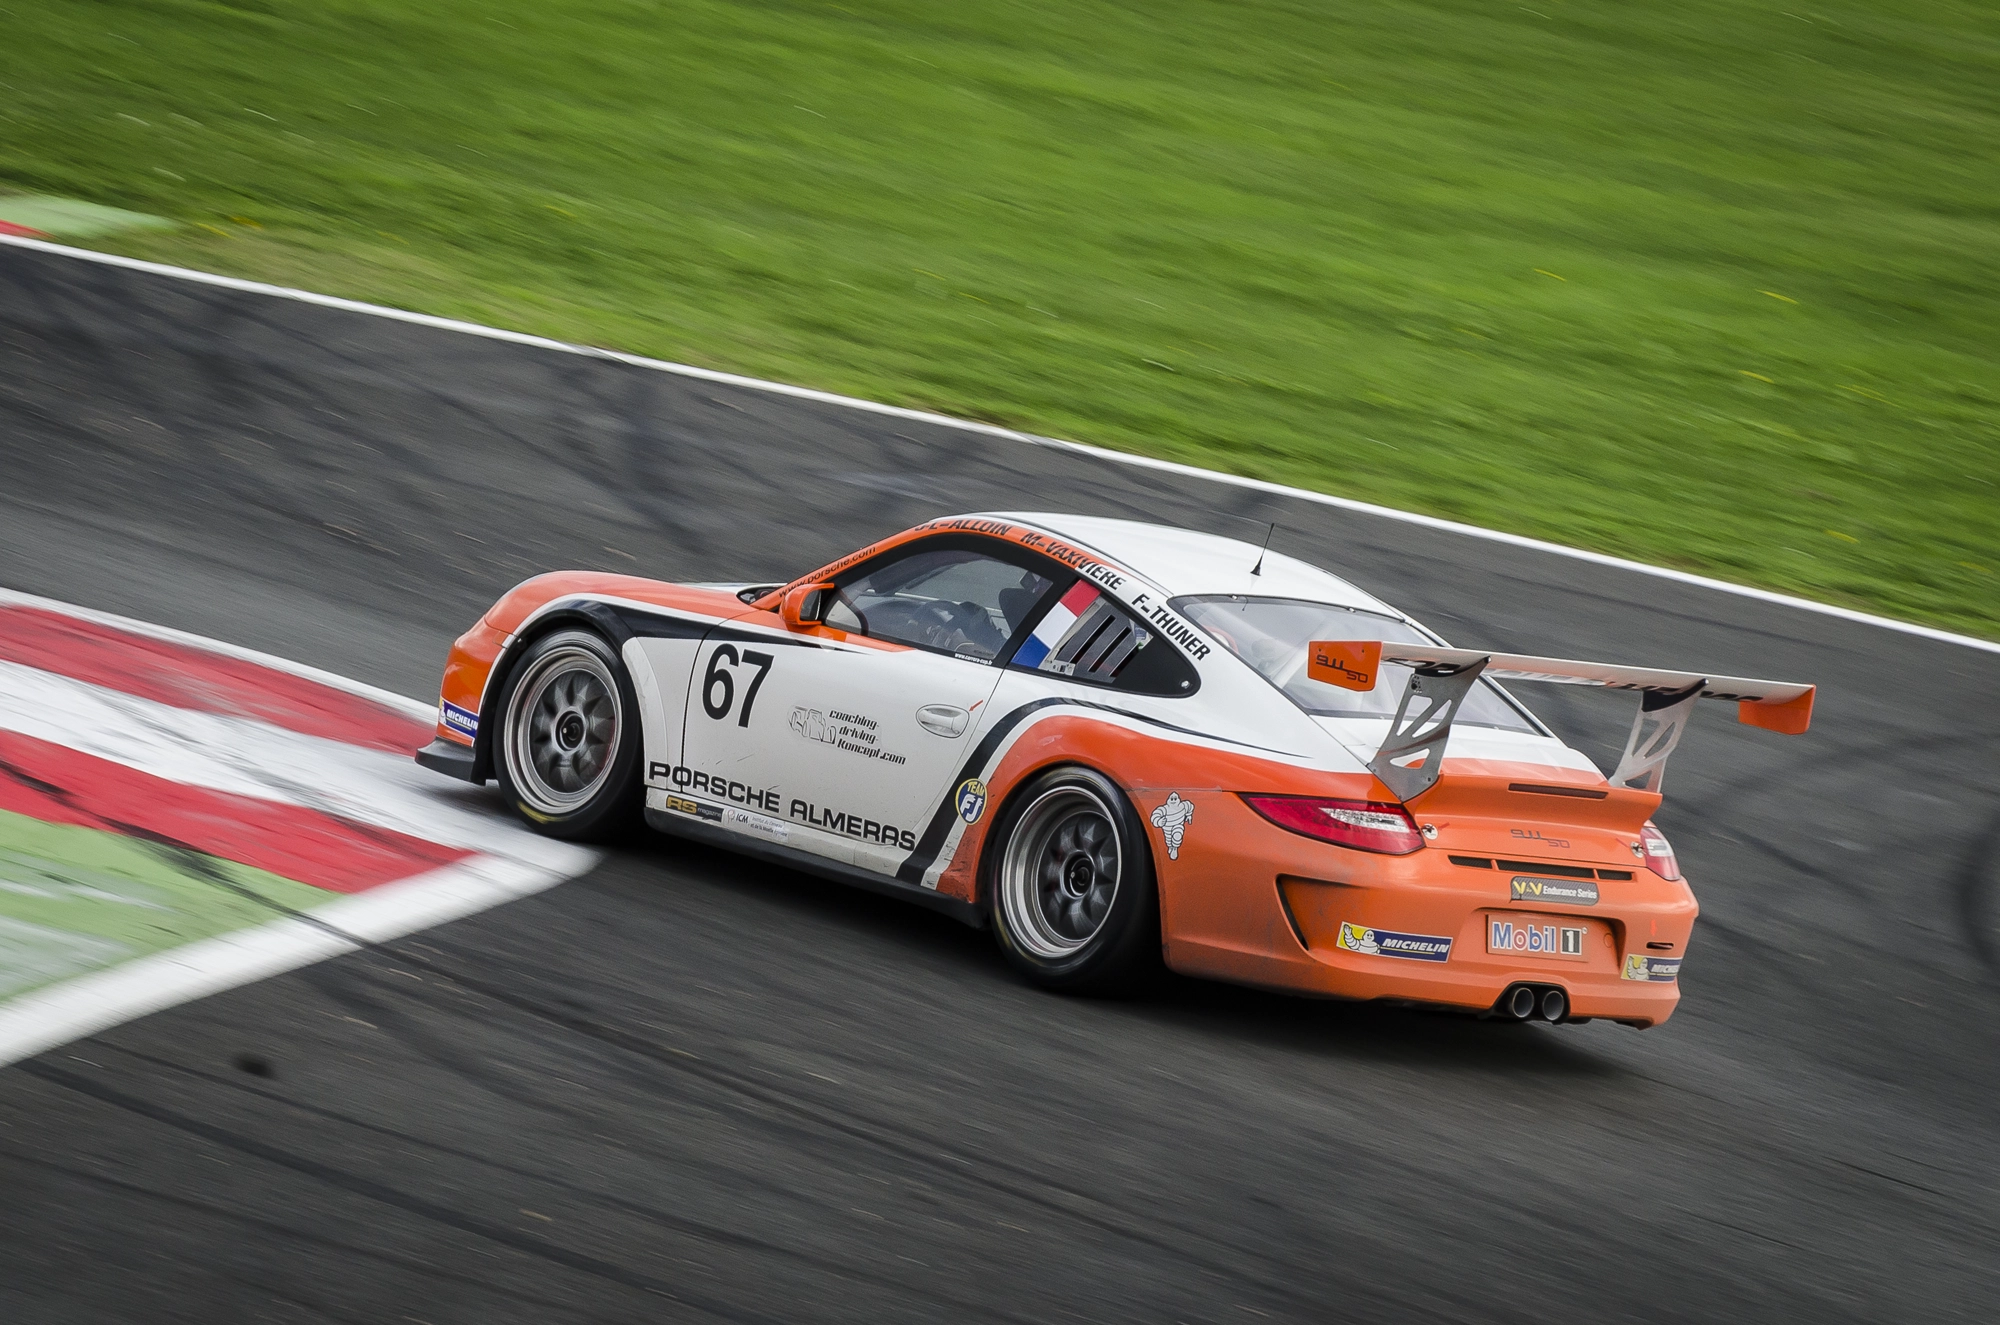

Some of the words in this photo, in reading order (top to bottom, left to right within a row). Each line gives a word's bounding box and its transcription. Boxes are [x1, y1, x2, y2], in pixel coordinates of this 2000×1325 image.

[702, 643, 775, 728] 67
[446, 708, 479, 731] MICHELIN
[967, 781, 986, 797] TEAM
[648, 760, 780, 813] PORSCHE
[790, 798, 916, 852] ALMERAS
[666, 796, 698, 814] RS
[697, 806, 722, 818] magazine
[735, 813, 749, 824] ICM
[1513, 880, 1527, 895] V
[1529, 881, 1543, 896] V
[1542, 885, 1577, 897] Endurance
[1577, 888, 1598, 899] Series
[1382, 938, 1450, 953] MICHELIN
[1492, 922, 1556, 953] Mobil
